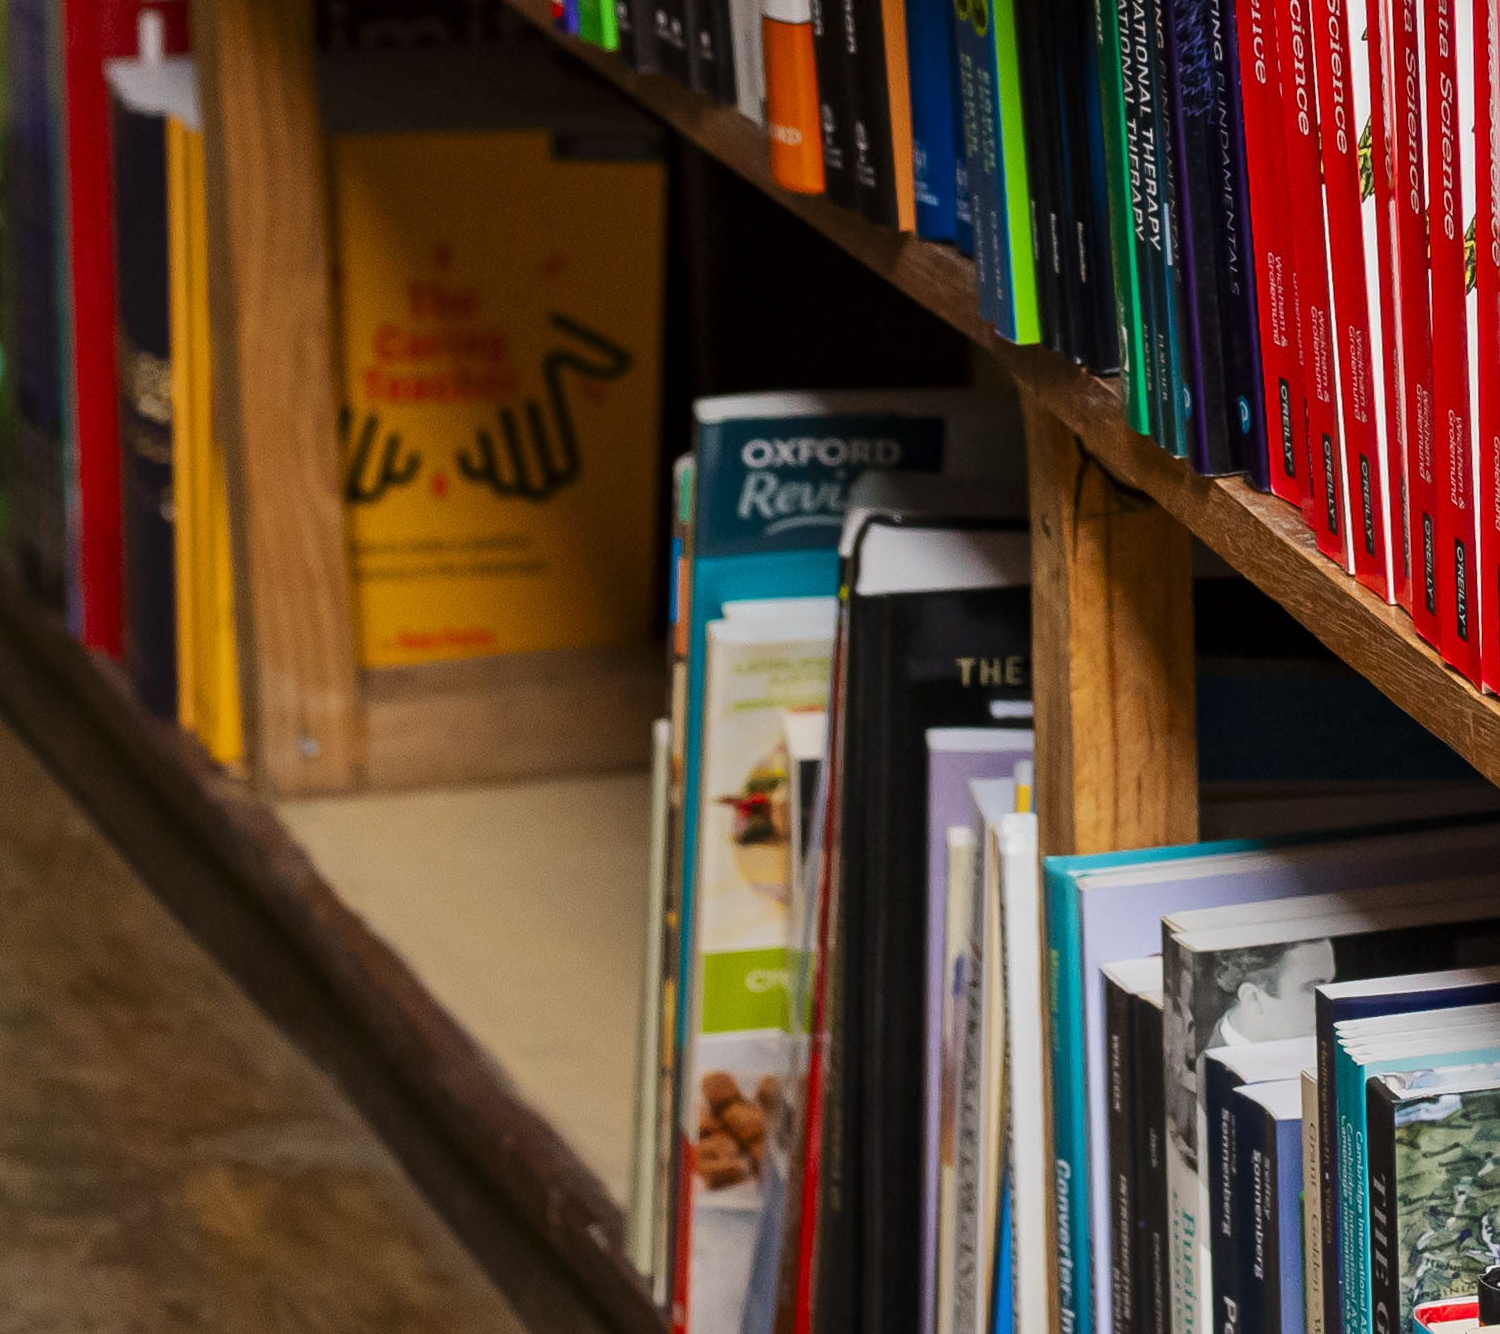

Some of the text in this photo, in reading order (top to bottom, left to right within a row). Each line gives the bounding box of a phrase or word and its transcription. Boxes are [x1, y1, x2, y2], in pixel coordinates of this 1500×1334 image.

[1404, 46, 1424, 215] Science
[1440, 73, 1458, 240] Science
[1127, 120, 1146, 242] THERAPY
[1141, 127, 1162, 251] THERAPY
[1211, 73, 1241, 296] FUNDAMENTALS
[1267, 250, 1281, 346] Grolemund
[1273, 255, 1285, 320] Wickham
[1311, 305, 1326, 376] Wickham
[1311, 305, 1324, 401] Grolemund
[1349, 324, 1362, 421] Grolemund
[1352, 330, 1364, 395] Wickham
[741, 437, 901, 470] OXFORD
[1279, 383, 1293, 464] O'REILLY
[1448, 409, 1461, 507] Grolemund
[1454, 415, 1465, 492] Wickham
[1322, 440, 1337, 522] O'REILLY
[1359, 459, 1375, 537] O'REILLY
[1421, 519, 1437, 598] O'REILLY
[1454, 546, 1469, 624] O'REILLY
[956, 657, 1026, 688] THE
[1219, 1108, 1235, 1237] Sonnenberg
[1251, 1149, 1266, 1280] Sonnenberg
[1307, 1122, 1322, 1294] Grant Golden
[1353, 1131, 1369, 1312] Cambridge International
[1371, 1173, 1388, 1282] THE
